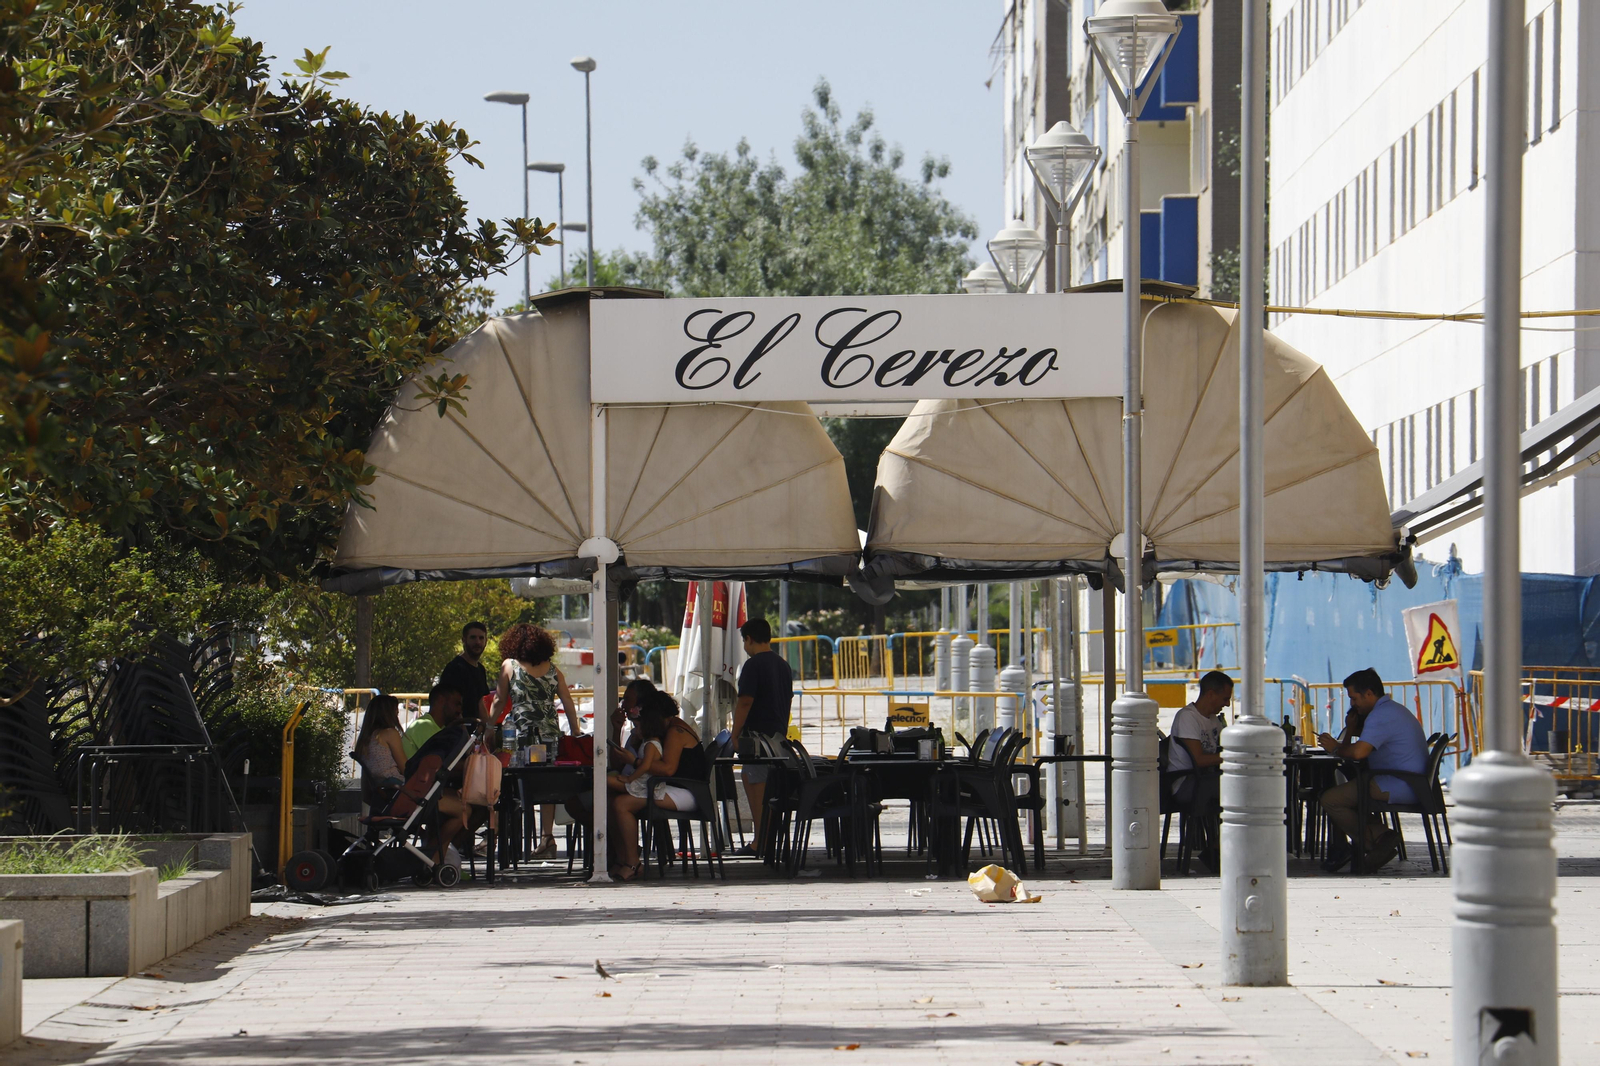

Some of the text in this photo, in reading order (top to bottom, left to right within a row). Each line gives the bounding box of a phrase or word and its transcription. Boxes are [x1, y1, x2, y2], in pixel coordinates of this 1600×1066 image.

[674, 307, 1060, 390] El Cerezo
[891, 713, 927, 723] elecnor
